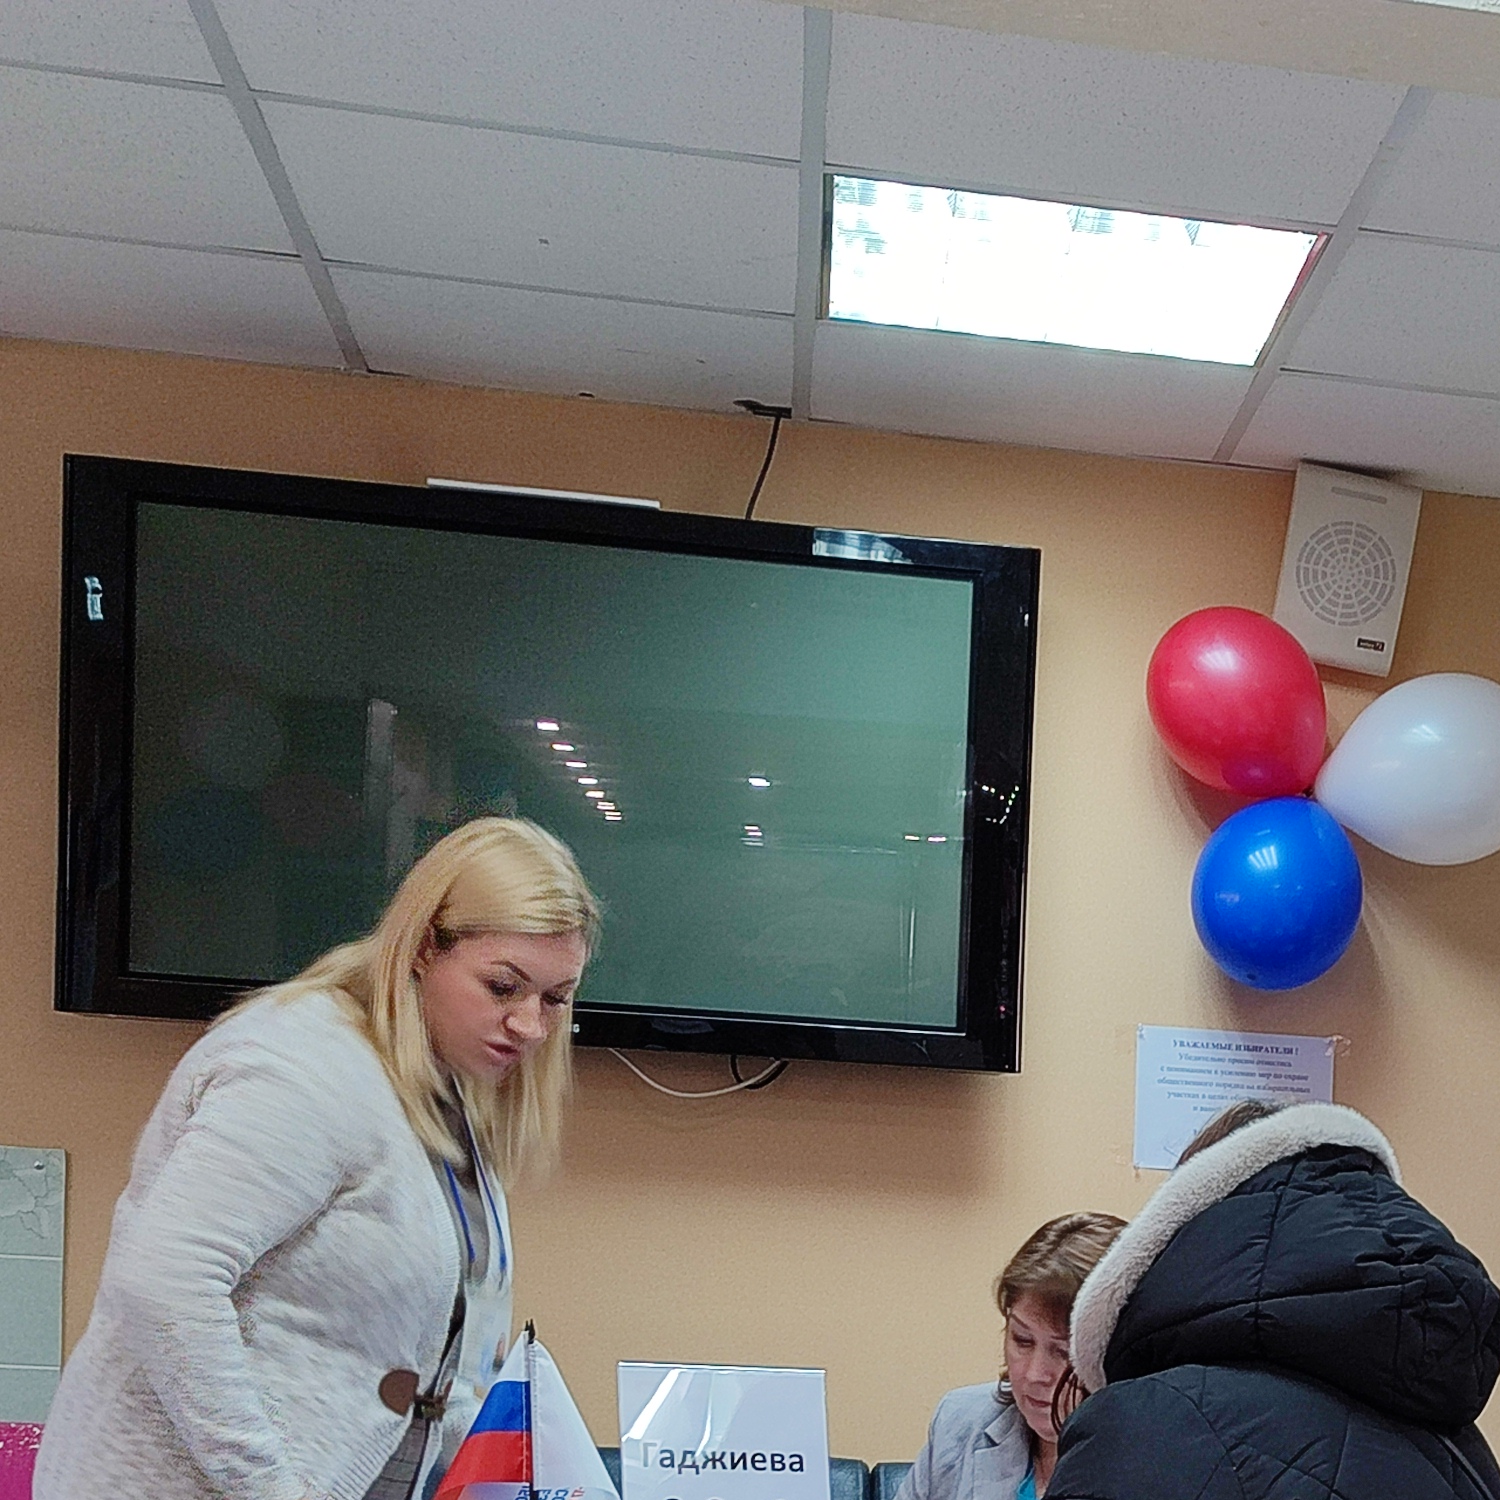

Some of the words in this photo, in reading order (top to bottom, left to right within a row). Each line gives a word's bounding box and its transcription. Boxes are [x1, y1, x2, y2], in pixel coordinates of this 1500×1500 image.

[1173, 1039, 1233, 1051] УВАЖАЕМЫЕ
[1178, 1052, 1226, 1062] Убедительно
[1157, 1076, 1213, 1087] общественного
[642, 1442, 804, 1475] Гаджиева
